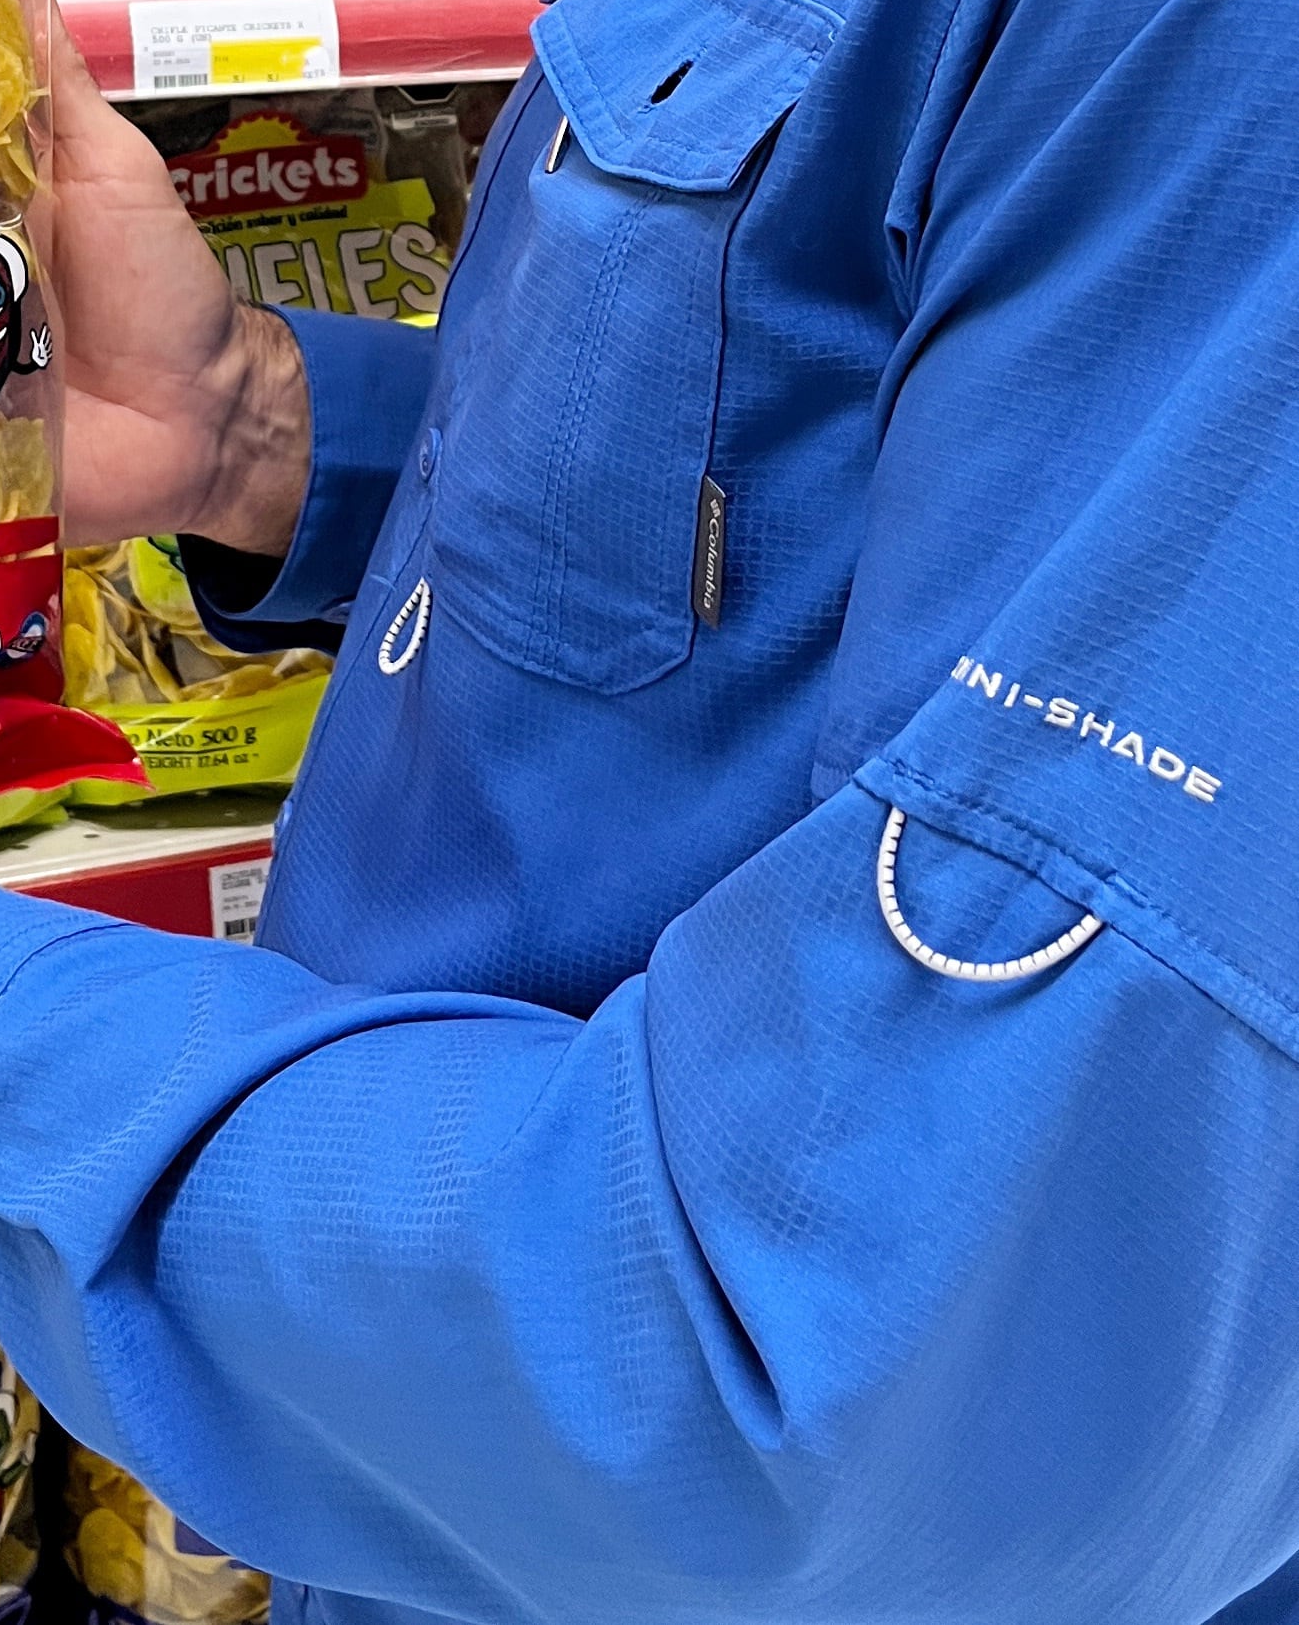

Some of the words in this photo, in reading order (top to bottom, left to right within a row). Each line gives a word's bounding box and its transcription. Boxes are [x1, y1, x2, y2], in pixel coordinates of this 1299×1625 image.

[703, 517, 720, 609] Columbia
[147, 727, 194, 748] Neto
[202, 725, 238, 748] 500
[244, 726, 257, 745] g
